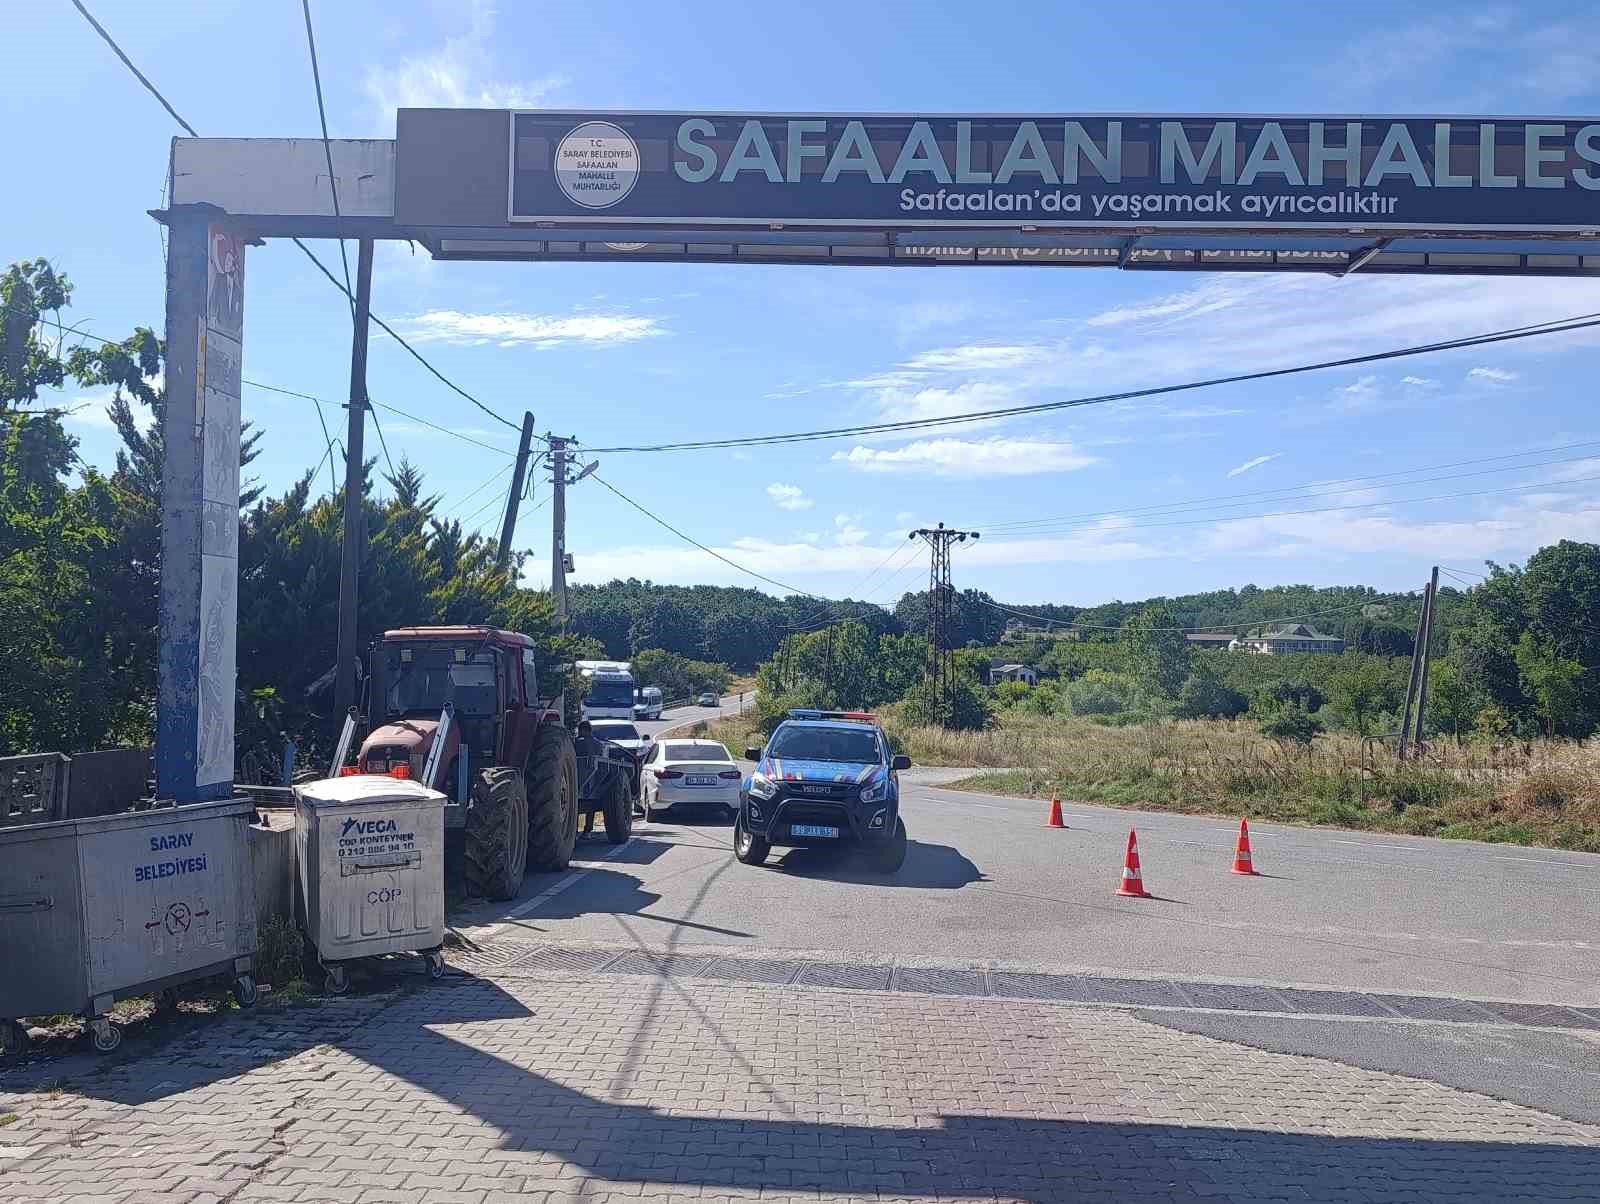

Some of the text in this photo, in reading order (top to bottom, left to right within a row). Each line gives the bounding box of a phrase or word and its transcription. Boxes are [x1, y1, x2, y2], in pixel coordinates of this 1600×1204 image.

[563, 150, 587, 158] SARAY
[672, 118, 1122, 184] SAFAALAN
[577, 161, 618, 169] SAFAALAN
[579, 172, 617, 180] MAHALLE
[899, 188, 1398, 218] Safaalan'da yaşamak ayrıcalıktır
[356, 819, 397, 834] VEGA
[150, 832, 193, 851] SARAY
[360, 832, 415, 846] KONTEYNER
[135, 852, 207, 882] BELEDİYESİ
